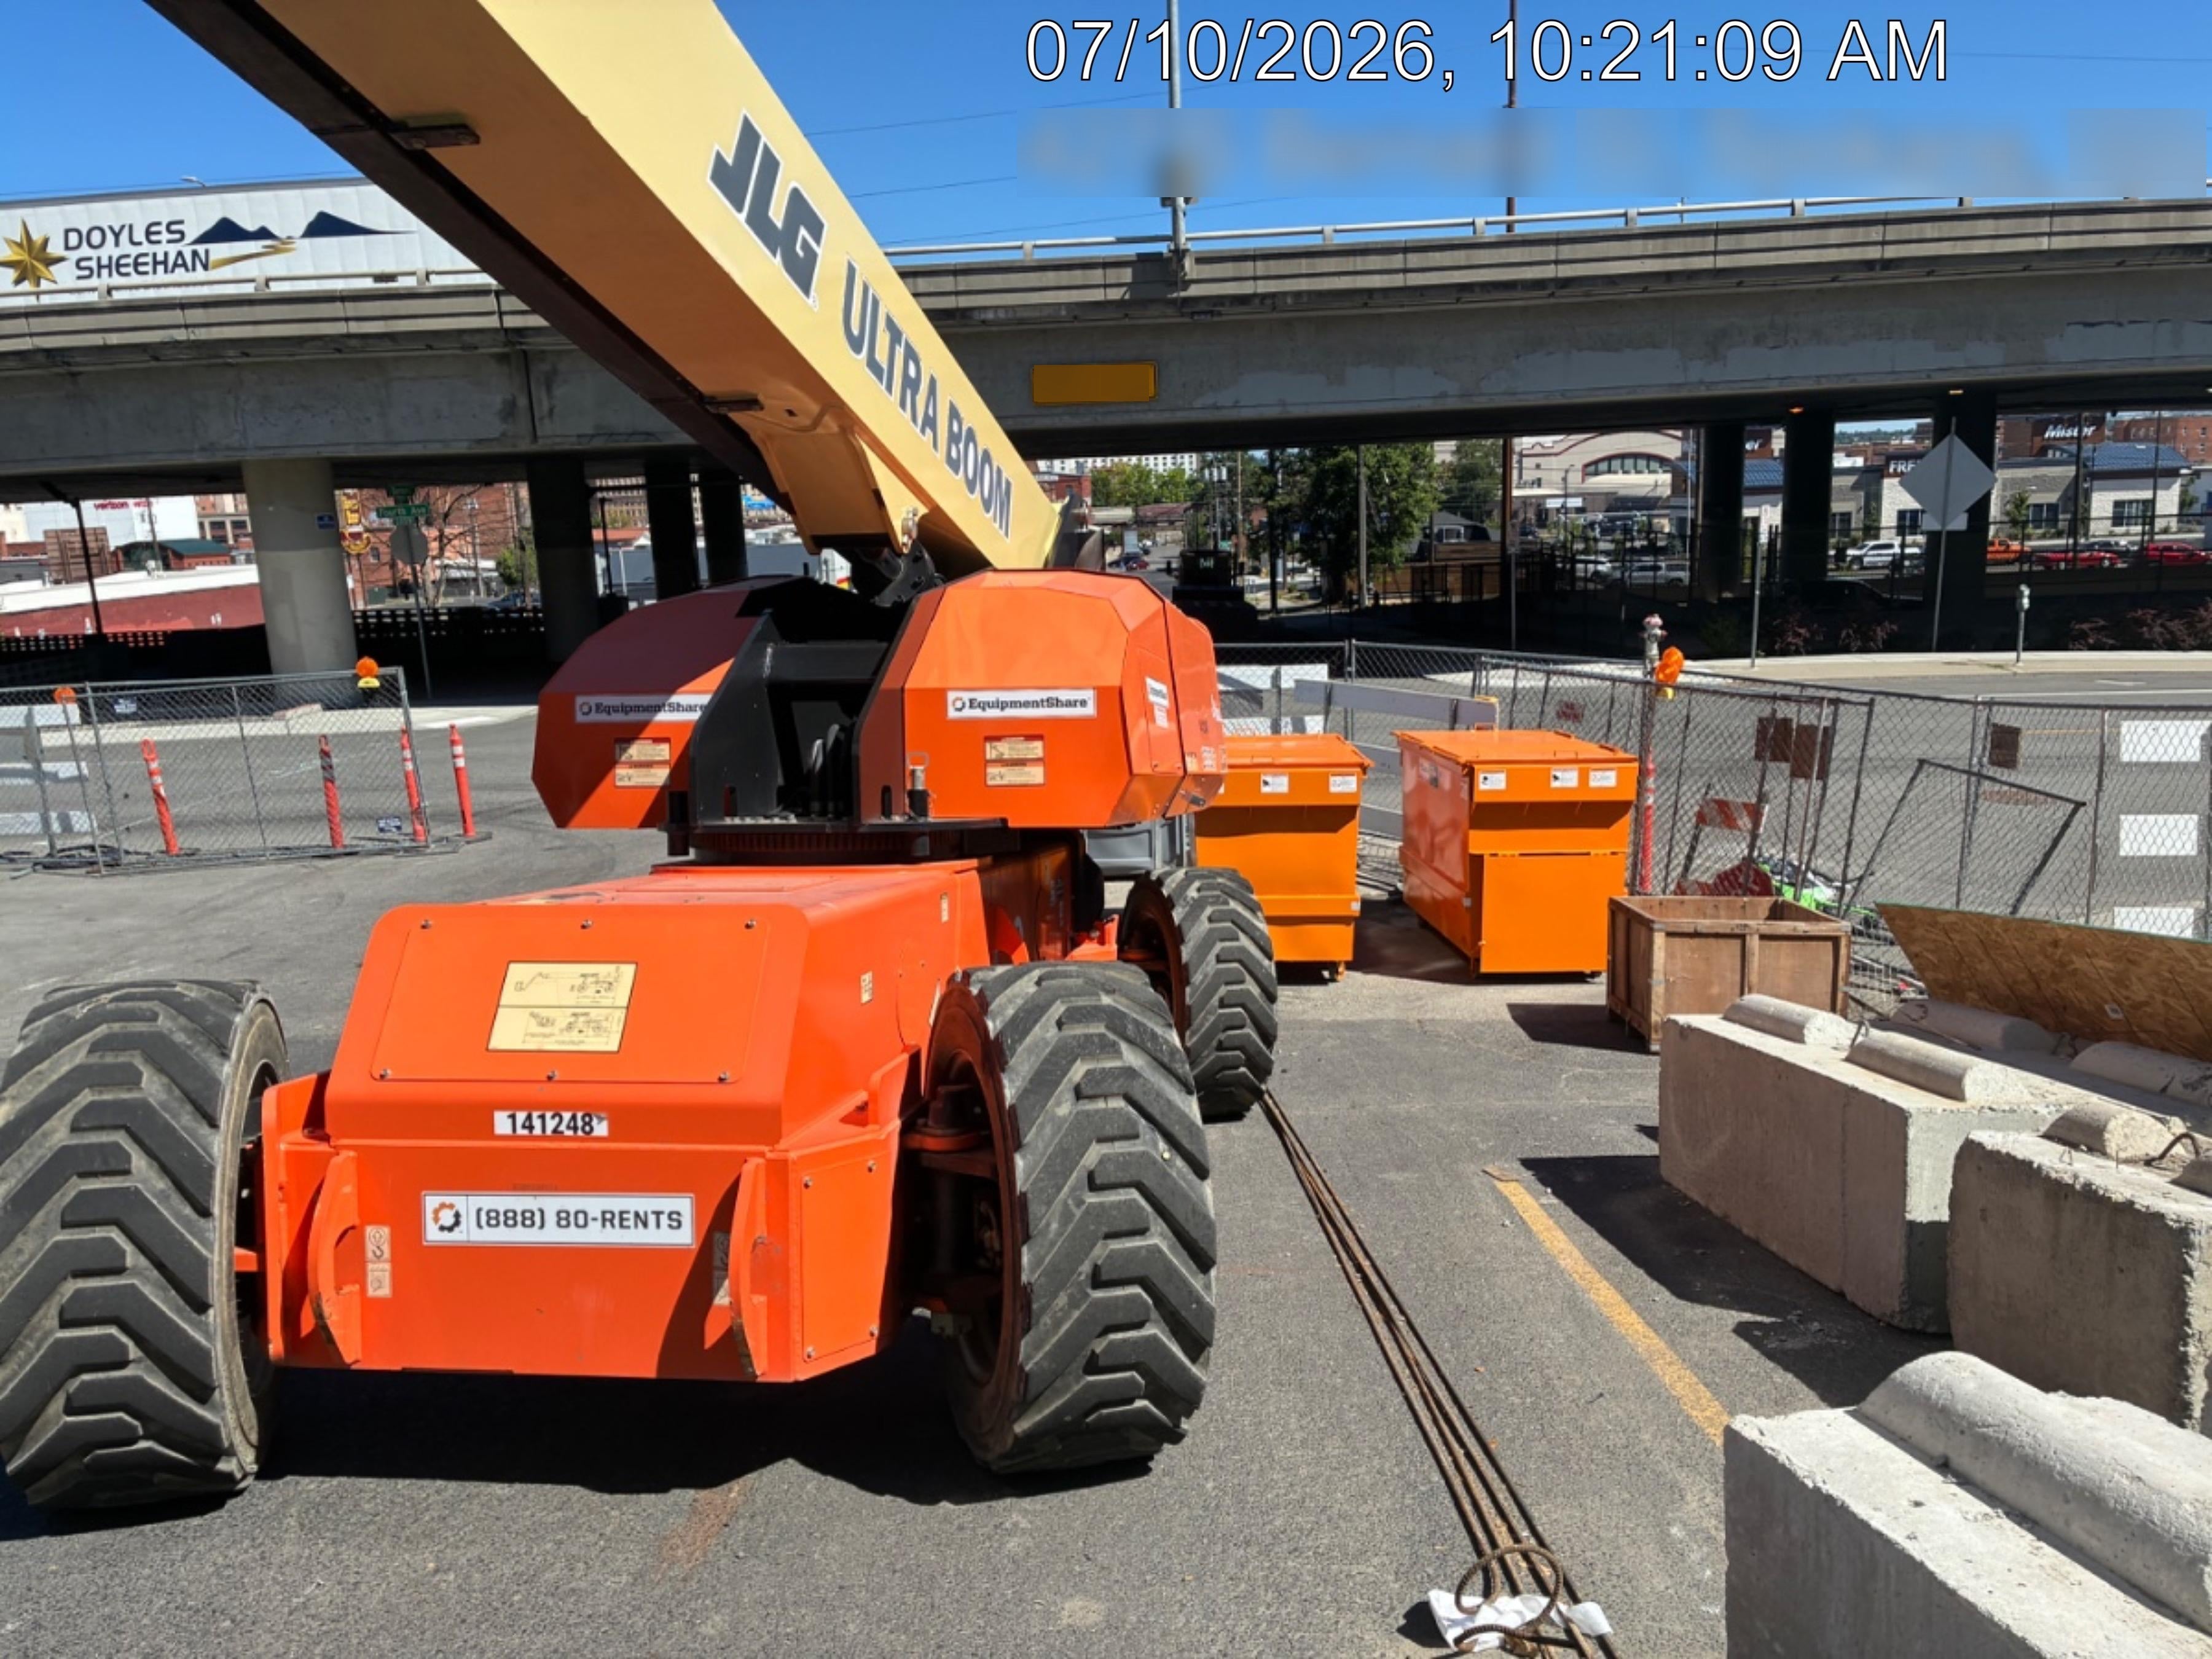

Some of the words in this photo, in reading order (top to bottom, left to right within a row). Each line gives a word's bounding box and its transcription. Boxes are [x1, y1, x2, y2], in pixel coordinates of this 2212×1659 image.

[707, 108, 827, 305] JLG
[63, 219, 186, 251] DOYLES
[75, 248, 210, 280] SHEEHAN
[841, 255, 940, 453] ULTRA
[946, 396, 1013, 541] BOOM
[968, 696, 1088, 712] EquipmentShare
[506, 1112, 595, 1135] 141248
[474, 1207, 546, 1230] (888)
[555, 1209, 683, 1231] 80-RENTS
